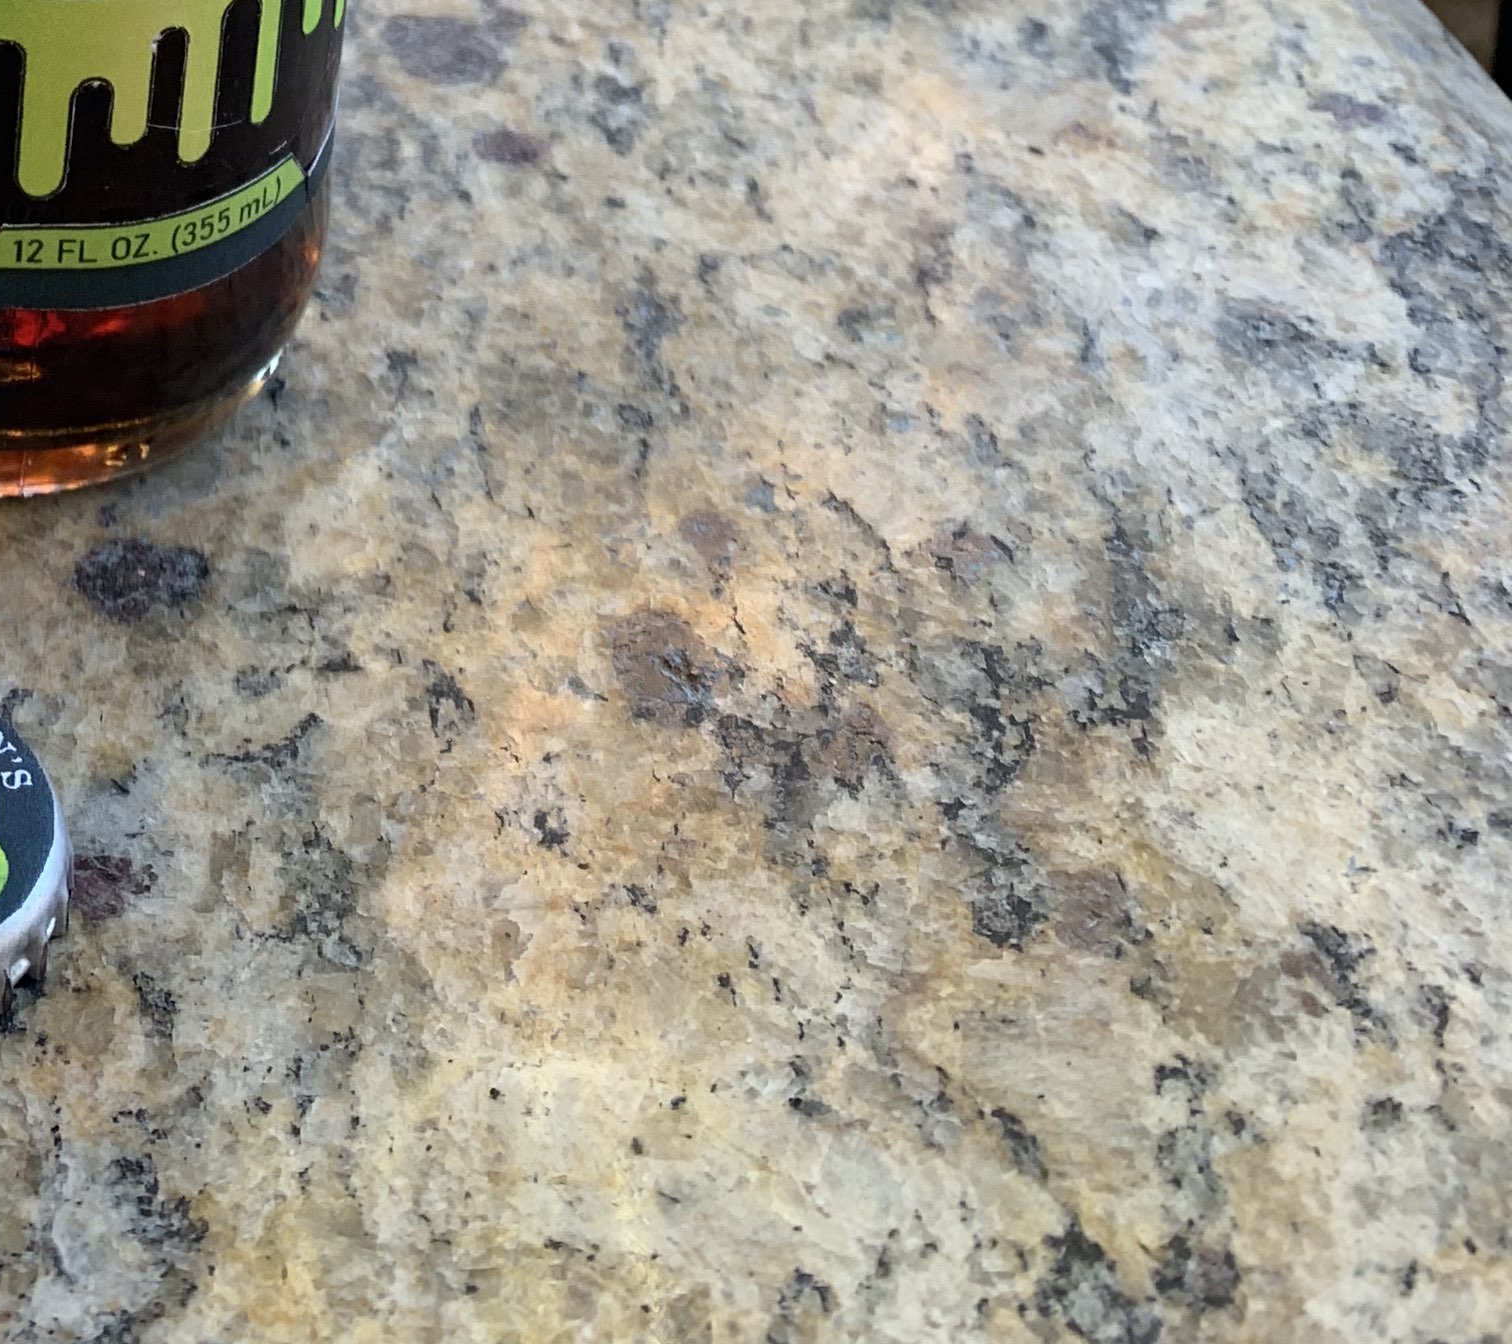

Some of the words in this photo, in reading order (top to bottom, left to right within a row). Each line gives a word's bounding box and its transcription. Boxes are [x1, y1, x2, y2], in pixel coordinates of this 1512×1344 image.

[13, 238, 43, 263] 12
[57, 239, 98, 263] FL
[110, 234, 158, 261] OZ.
[171, 207, 231, 254] (355
[238, 175, 282, 224] mL)
